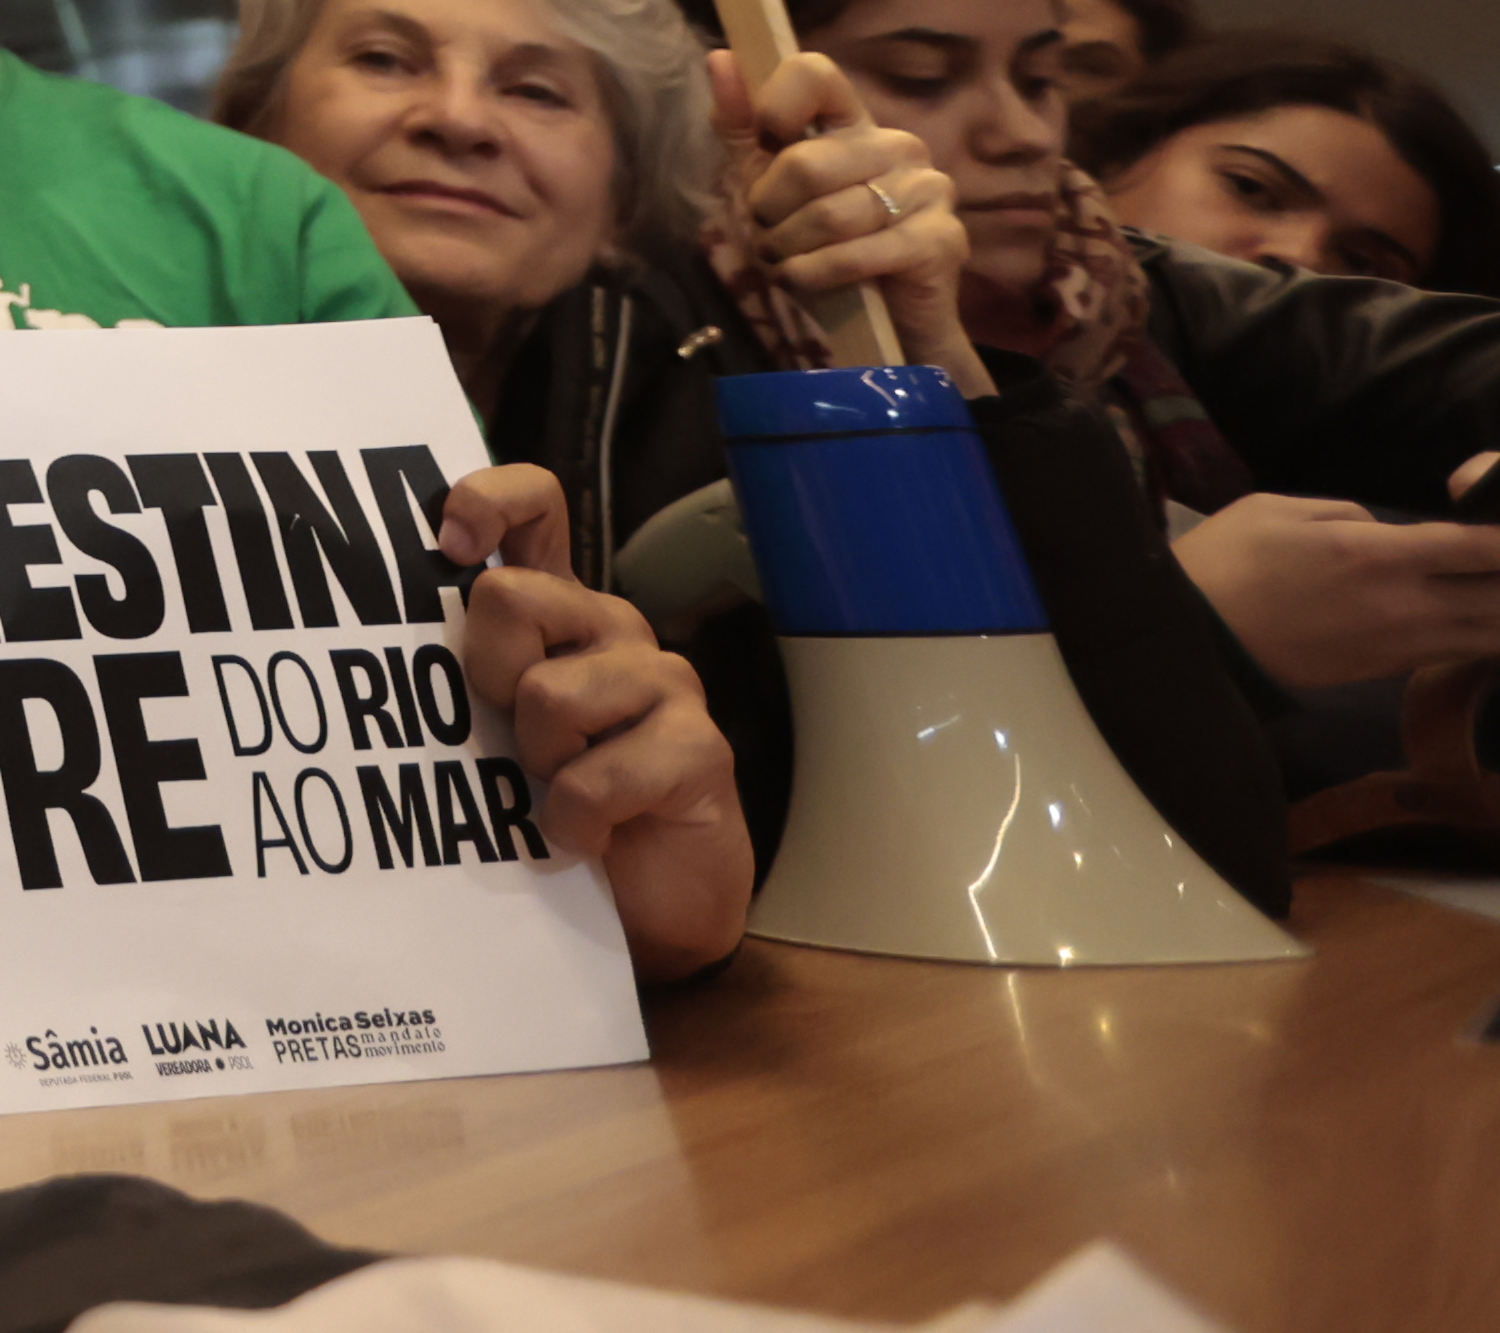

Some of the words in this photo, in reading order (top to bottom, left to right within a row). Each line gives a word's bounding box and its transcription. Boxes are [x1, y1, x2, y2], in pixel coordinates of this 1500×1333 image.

[210, 650, 325, 757] DO
[328, 644, 472, 750] RIO
[252, 766, 353, 878] AO
[356, 756, 550, 870] MAR
[25, 1025, 128, 1071] Sâmia
[142, 1018, 248, 1055] LUANA
[273, 1034, 362, 1064] PRETAS
